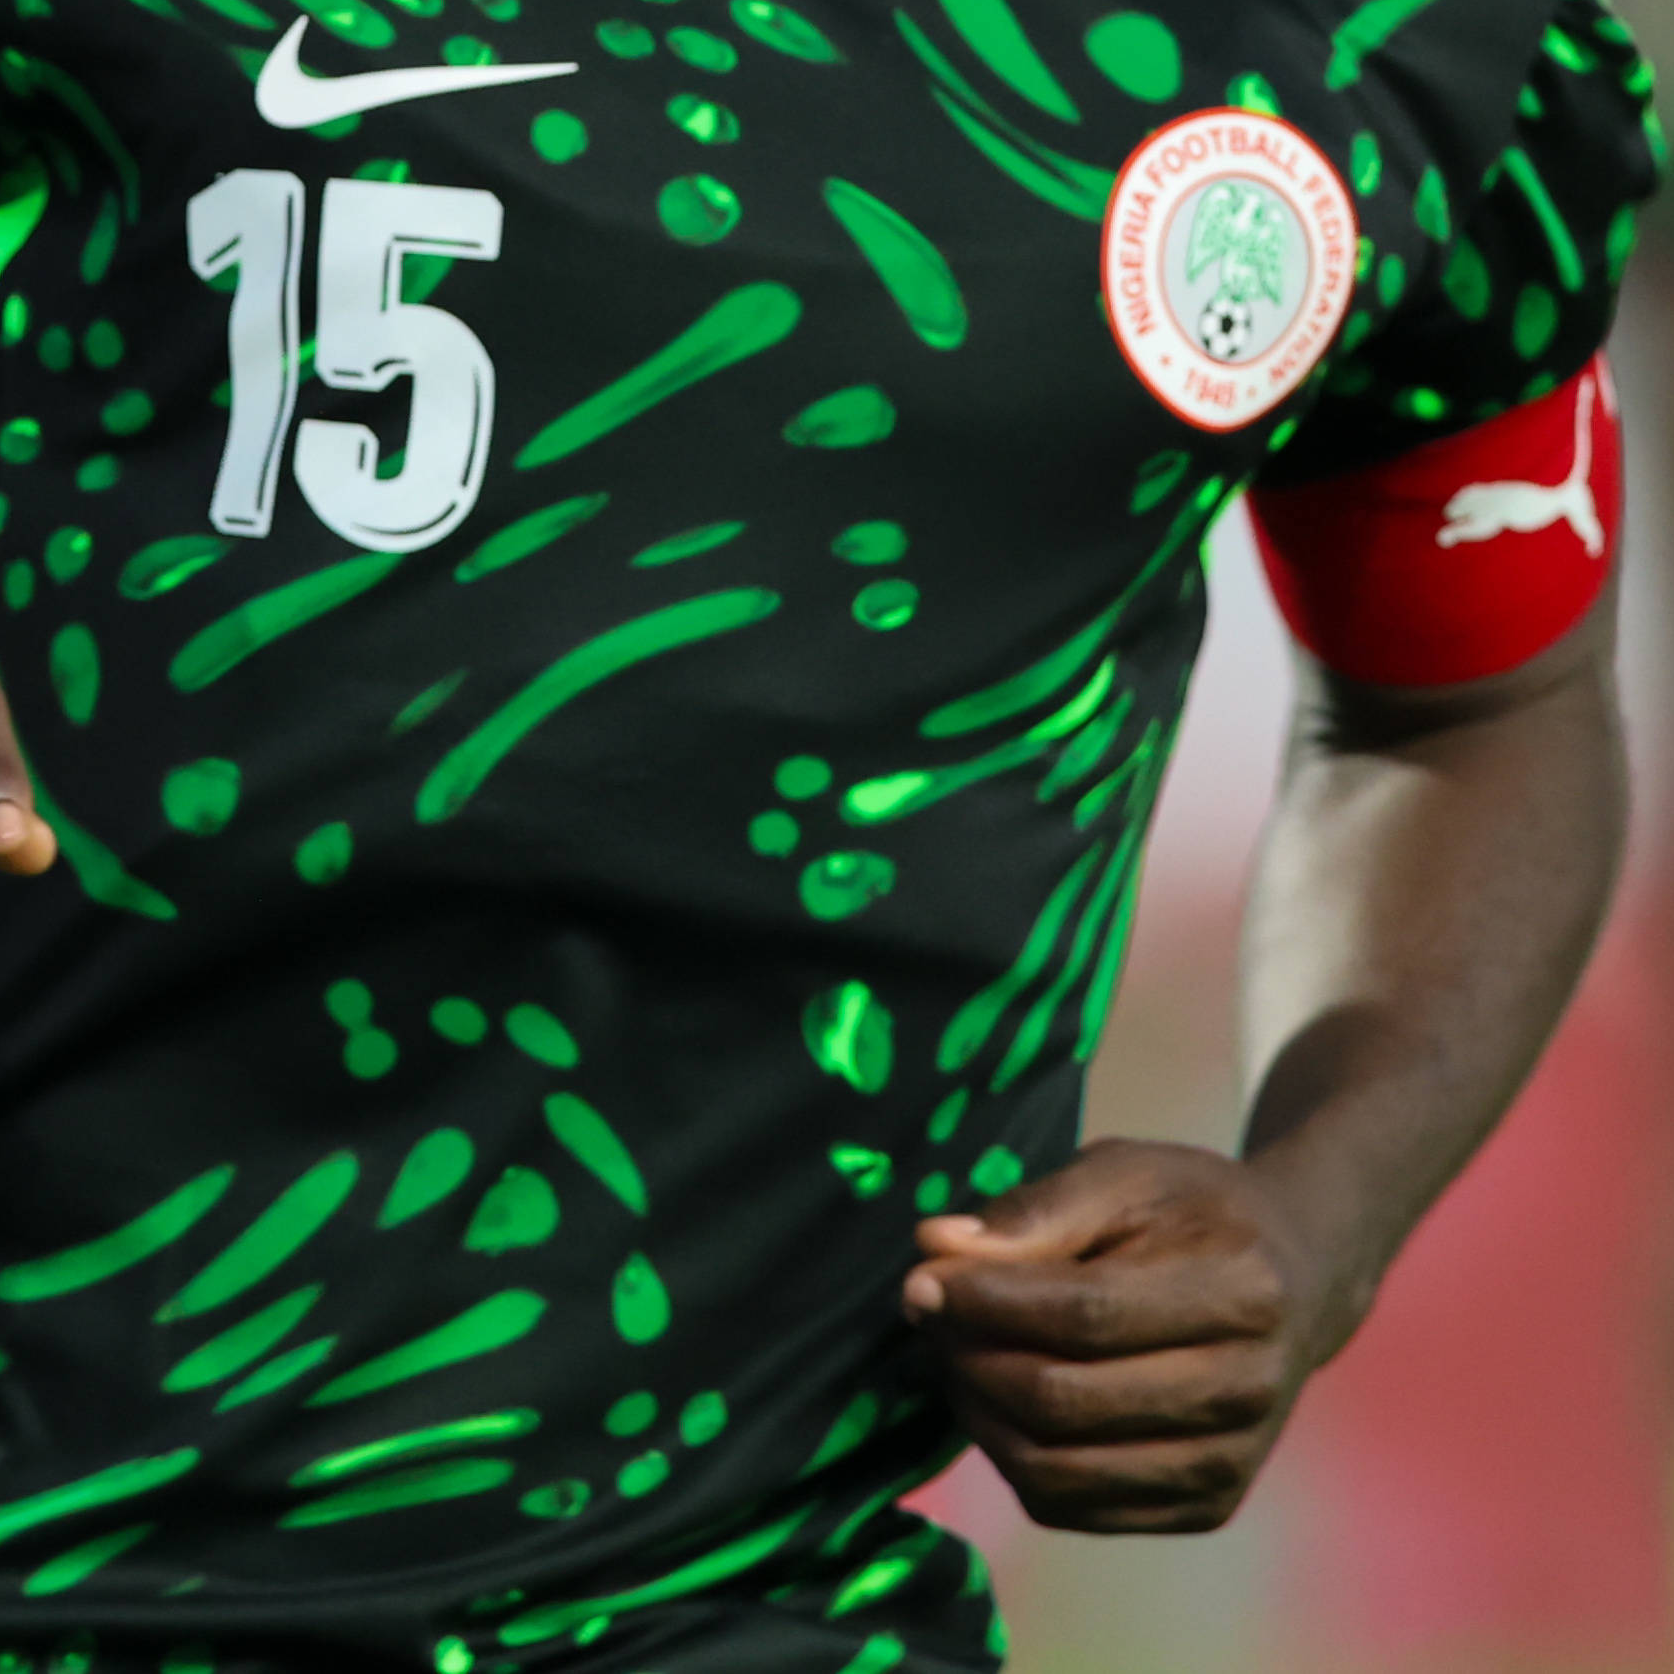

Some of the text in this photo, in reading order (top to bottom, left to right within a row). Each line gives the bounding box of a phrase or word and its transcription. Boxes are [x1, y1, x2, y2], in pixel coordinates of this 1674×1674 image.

[186, 168, 505, 554] 15
[1119, 126, 1344, 384] NIGERIA FOOTBALL FEDERATION
